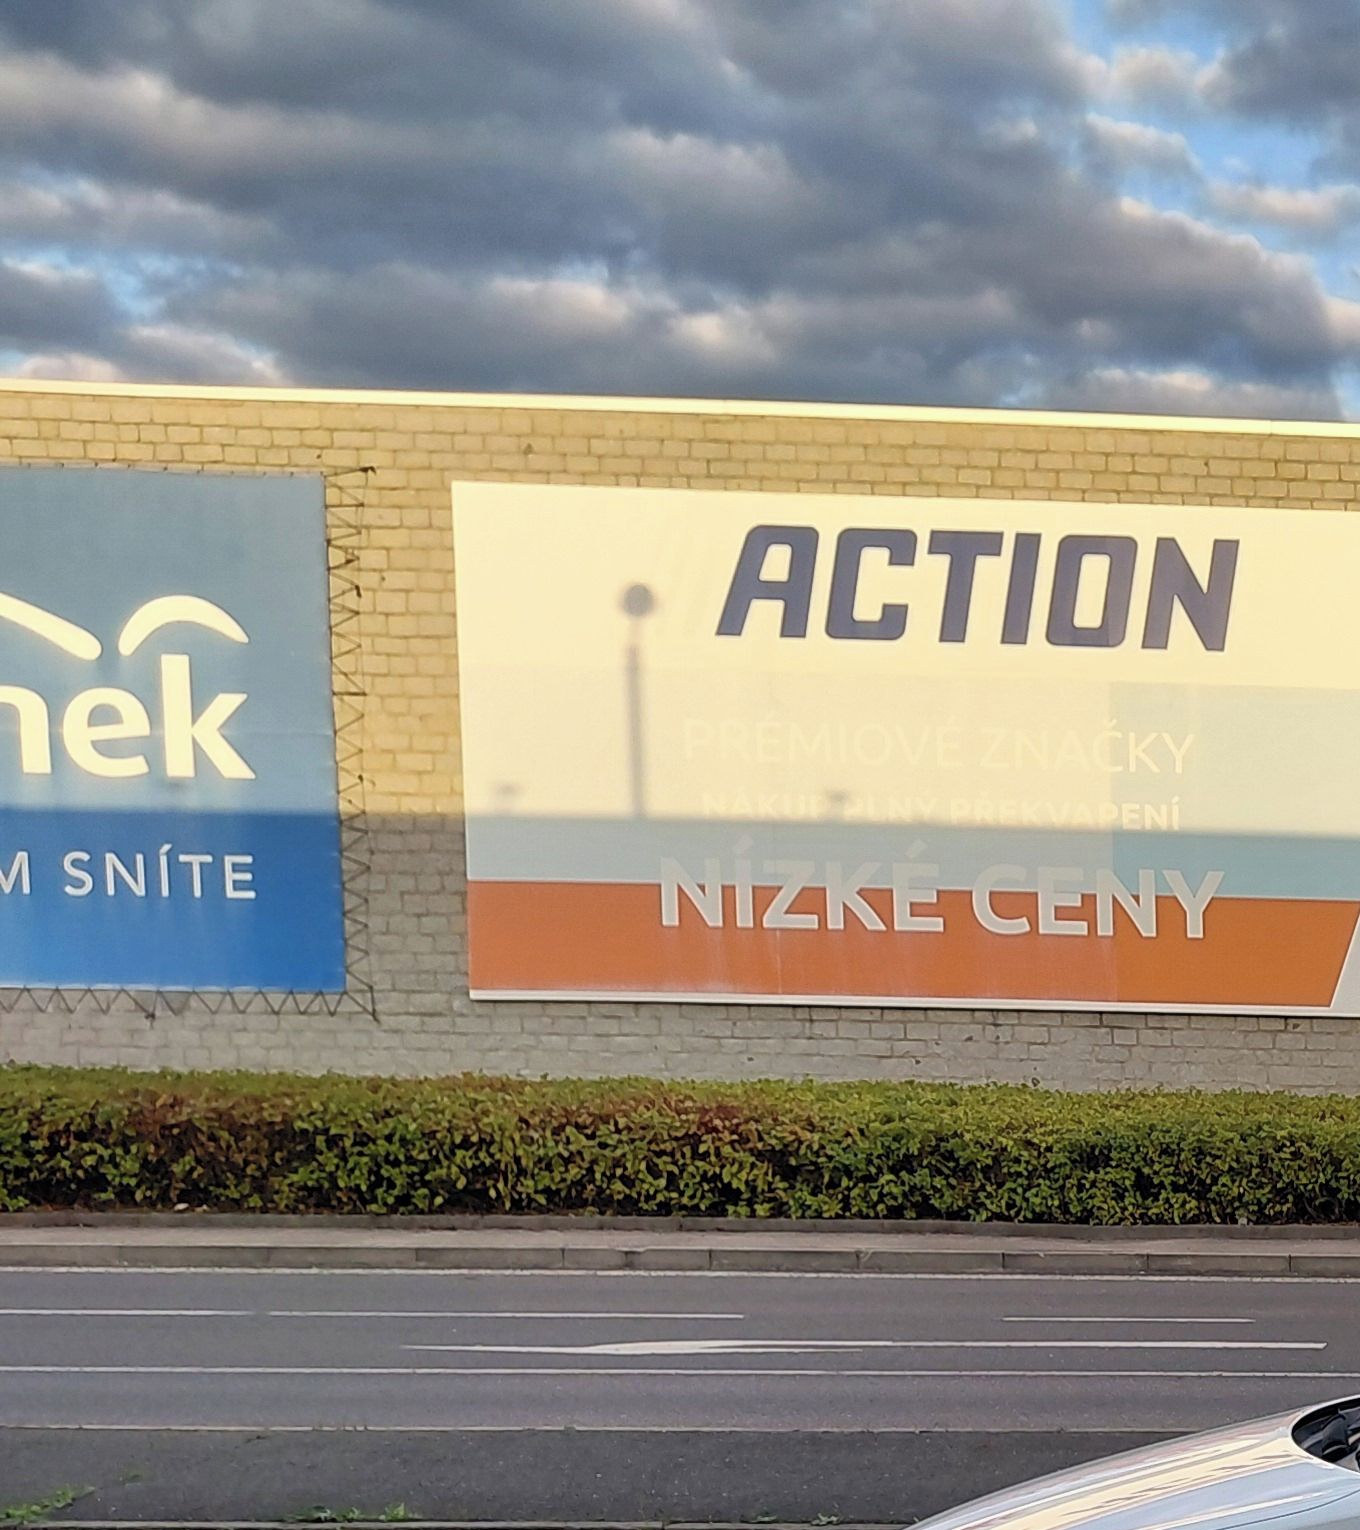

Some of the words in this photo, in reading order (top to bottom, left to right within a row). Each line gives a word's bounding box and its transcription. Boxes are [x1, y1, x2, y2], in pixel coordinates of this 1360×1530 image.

[714, 523, 1241, 653] ACTION
[683, 710, 964, 770] PRÉMIOVÉ
[978, 717, 1197, 775] ZNAČKY
[949, 790, 1182, 831] PŘEKVAPENÍ
[63, 843, 257, 900] SNÍTE
[660, 834, 945, 933] NÍZKÉ
[971, 861, 1226, 940] CENY
